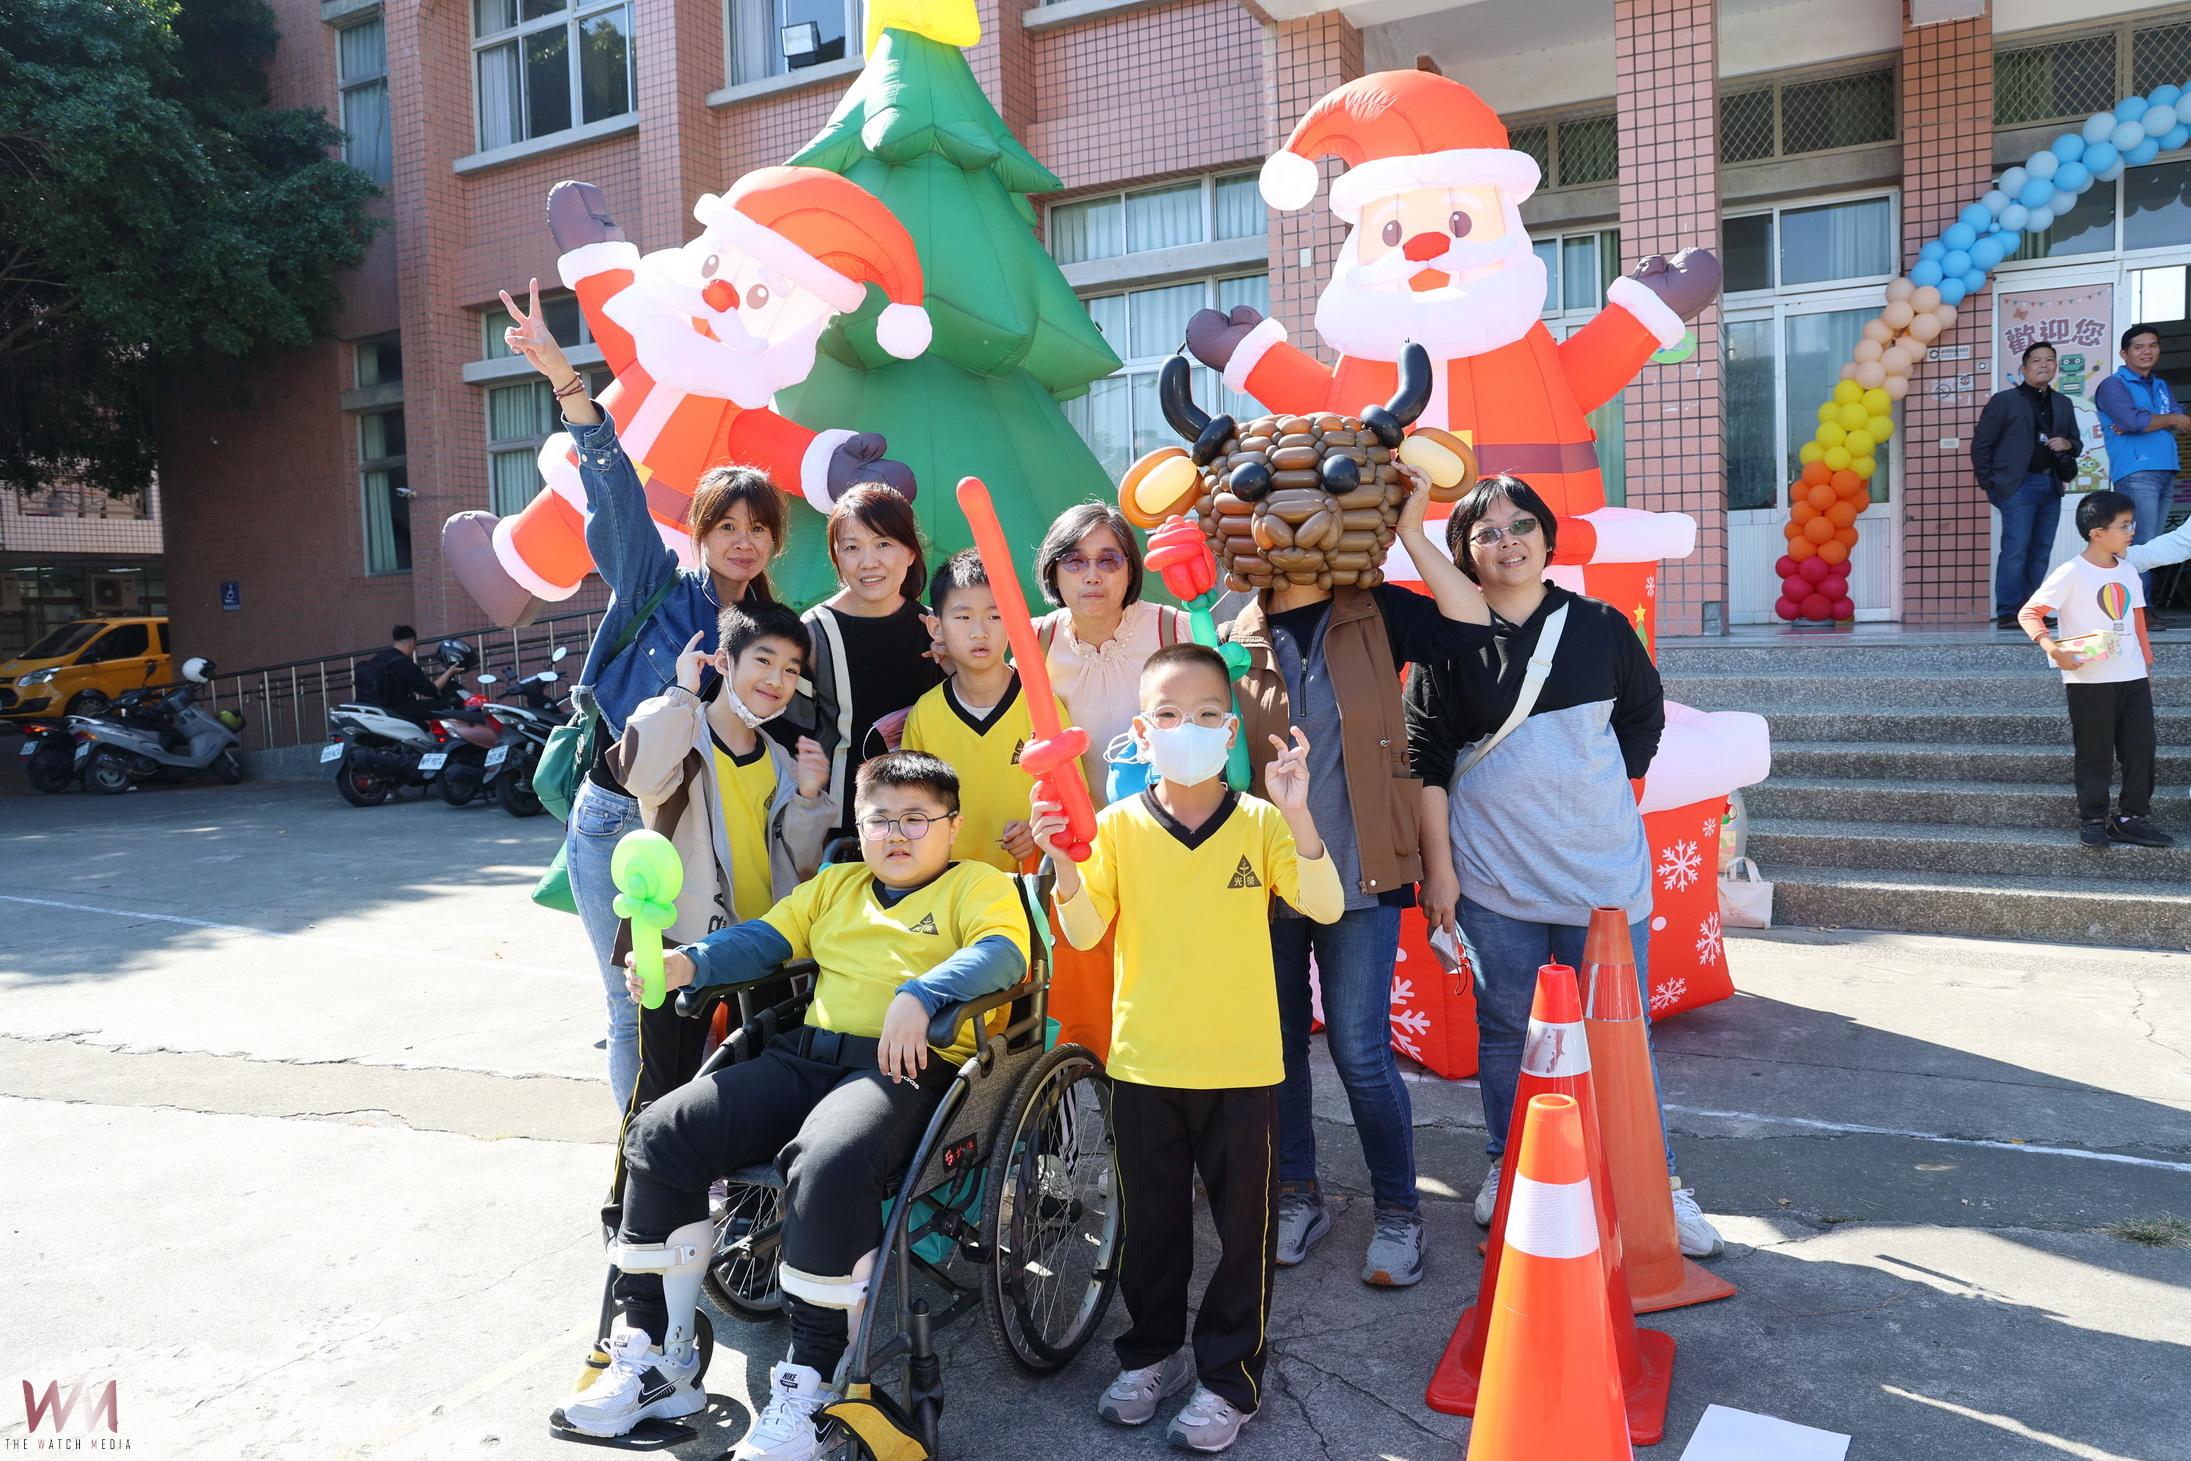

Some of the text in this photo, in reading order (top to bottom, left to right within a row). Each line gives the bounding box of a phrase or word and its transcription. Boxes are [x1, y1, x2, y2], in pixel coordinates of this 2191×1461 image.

[2005, 318, 2106, 356] 歡迎您
[782, 1371, 798, 1382] NIKE
